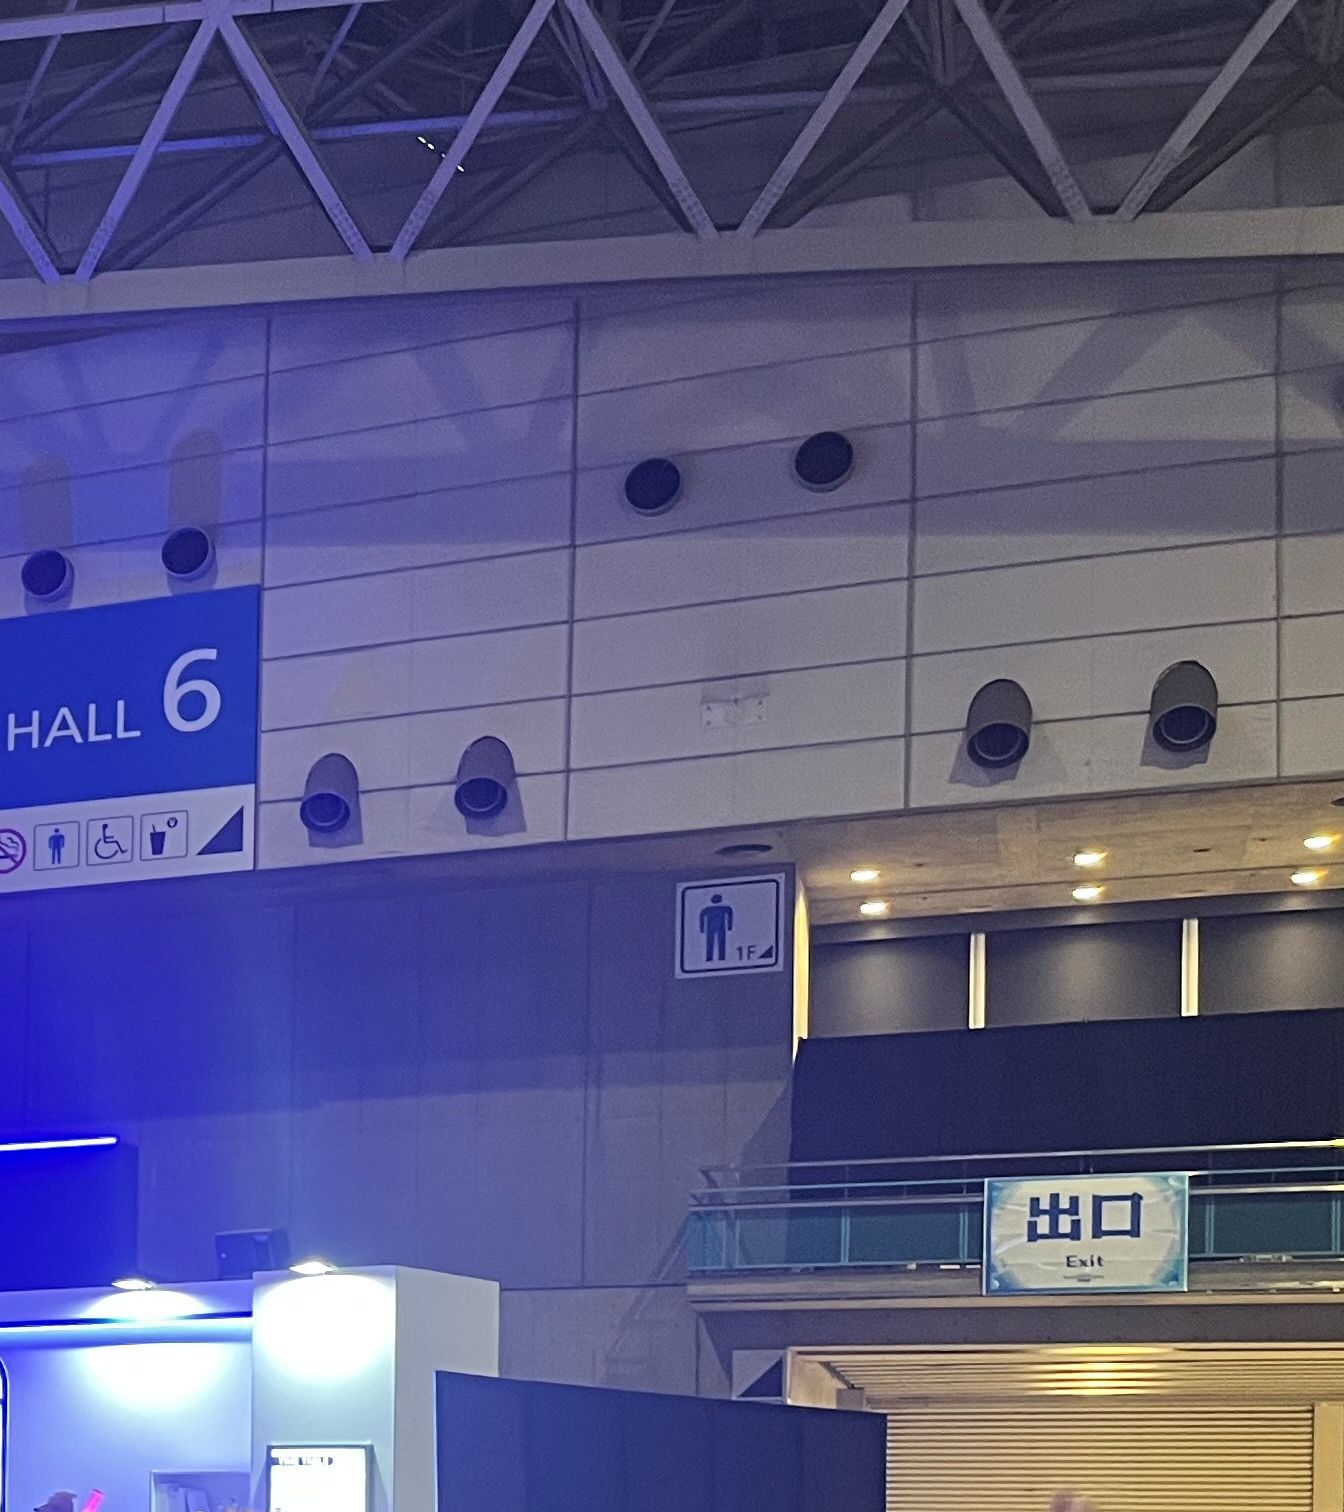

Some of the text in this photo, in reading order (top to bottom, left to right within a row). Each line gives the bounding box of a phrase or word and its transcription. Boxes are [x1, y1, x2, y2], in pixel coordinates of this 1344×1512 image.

[6, 647, 222, 751] HALL 6
[736, 945, 757, 961] 1F
[1026, 1191, 1144, 1243] 出口
[1065, 1254, 1105, 1268] Exit
